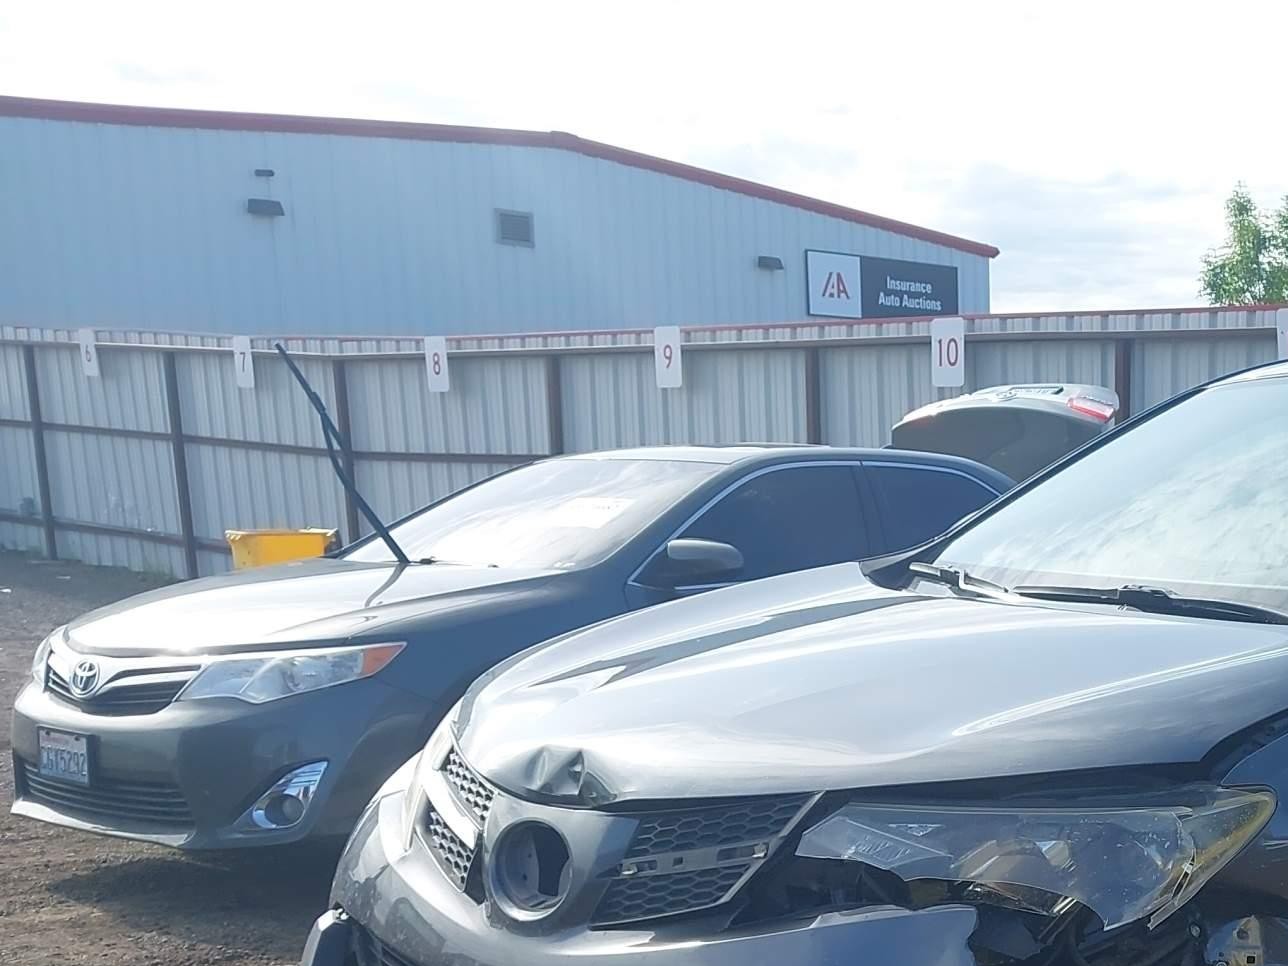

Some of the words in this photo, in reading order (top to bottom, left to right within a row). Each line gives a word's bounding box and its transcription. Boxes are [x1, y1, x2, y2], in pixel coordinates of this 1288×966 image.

[886, 276, 932, 294] Insurance
[878, 292, 900, 307] Auto
[902, 294, 942, 311] Auctions
[239, 351, 246, 373] 7
[432, 352, 441, 376] 8
[663, 344, 673, 369] 9
[938, 338, 959, 367] 10
